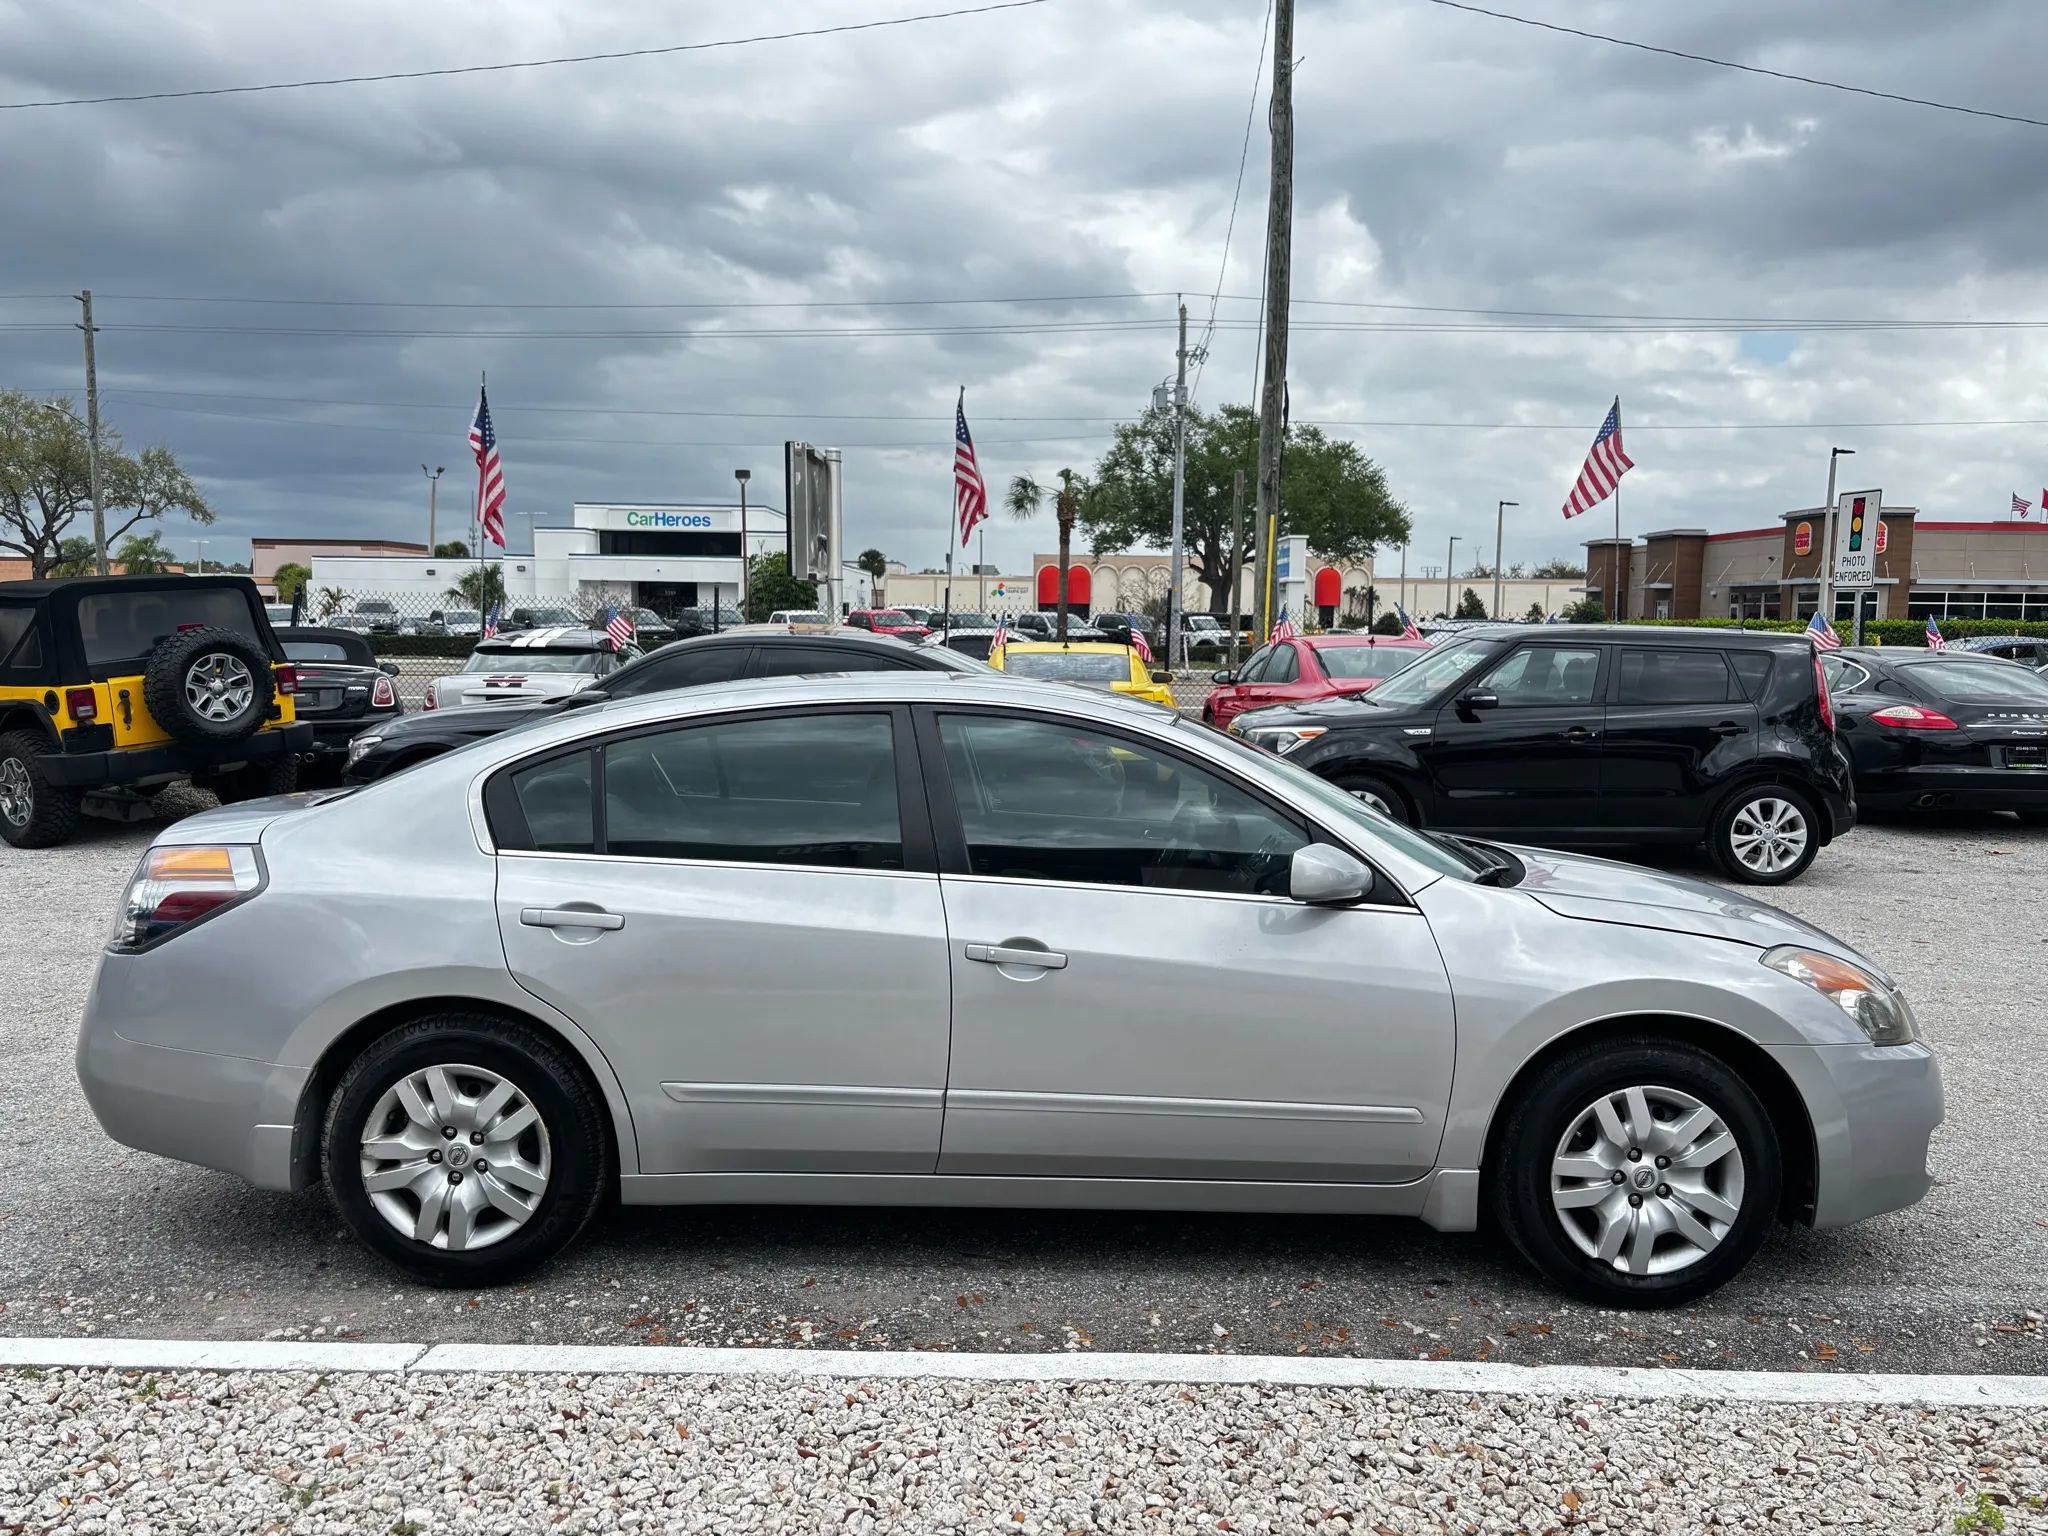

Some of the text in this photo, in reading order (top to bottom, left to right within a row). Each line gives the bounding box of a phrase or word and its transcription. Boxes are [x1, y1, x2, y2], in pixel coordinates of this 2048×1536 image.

[627, 511, 711, 527] CarHeroes
[1841, 555, 1866, 567] PHOTO
[1835, 571, 1871, 582] ENFORCED
